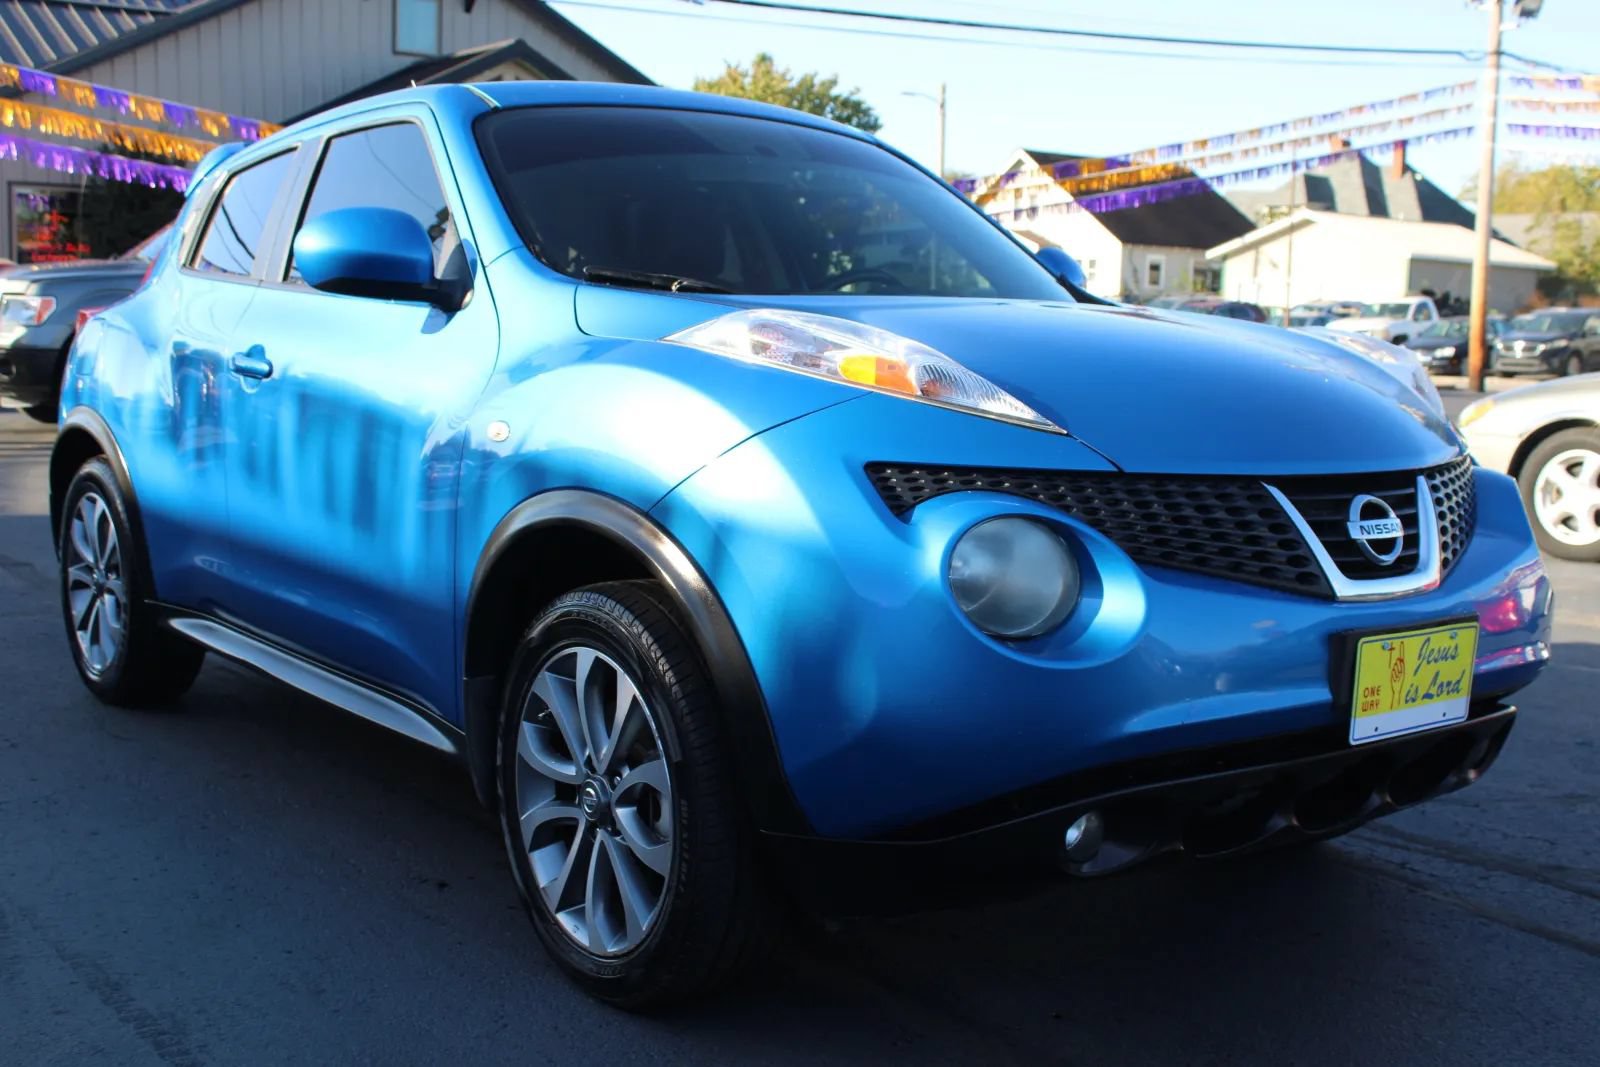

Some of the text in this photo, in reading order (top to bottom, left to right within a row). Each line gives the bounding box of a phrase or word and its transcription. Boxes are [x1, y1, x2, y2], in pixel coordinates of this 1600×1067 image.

[1413, 636, 1459, 677] Jesus
[1363, 685, 1381, 698] ONE
[1405, 669, 1466, 704] is Lord
[1362, 701, 1380, 712] WAY
